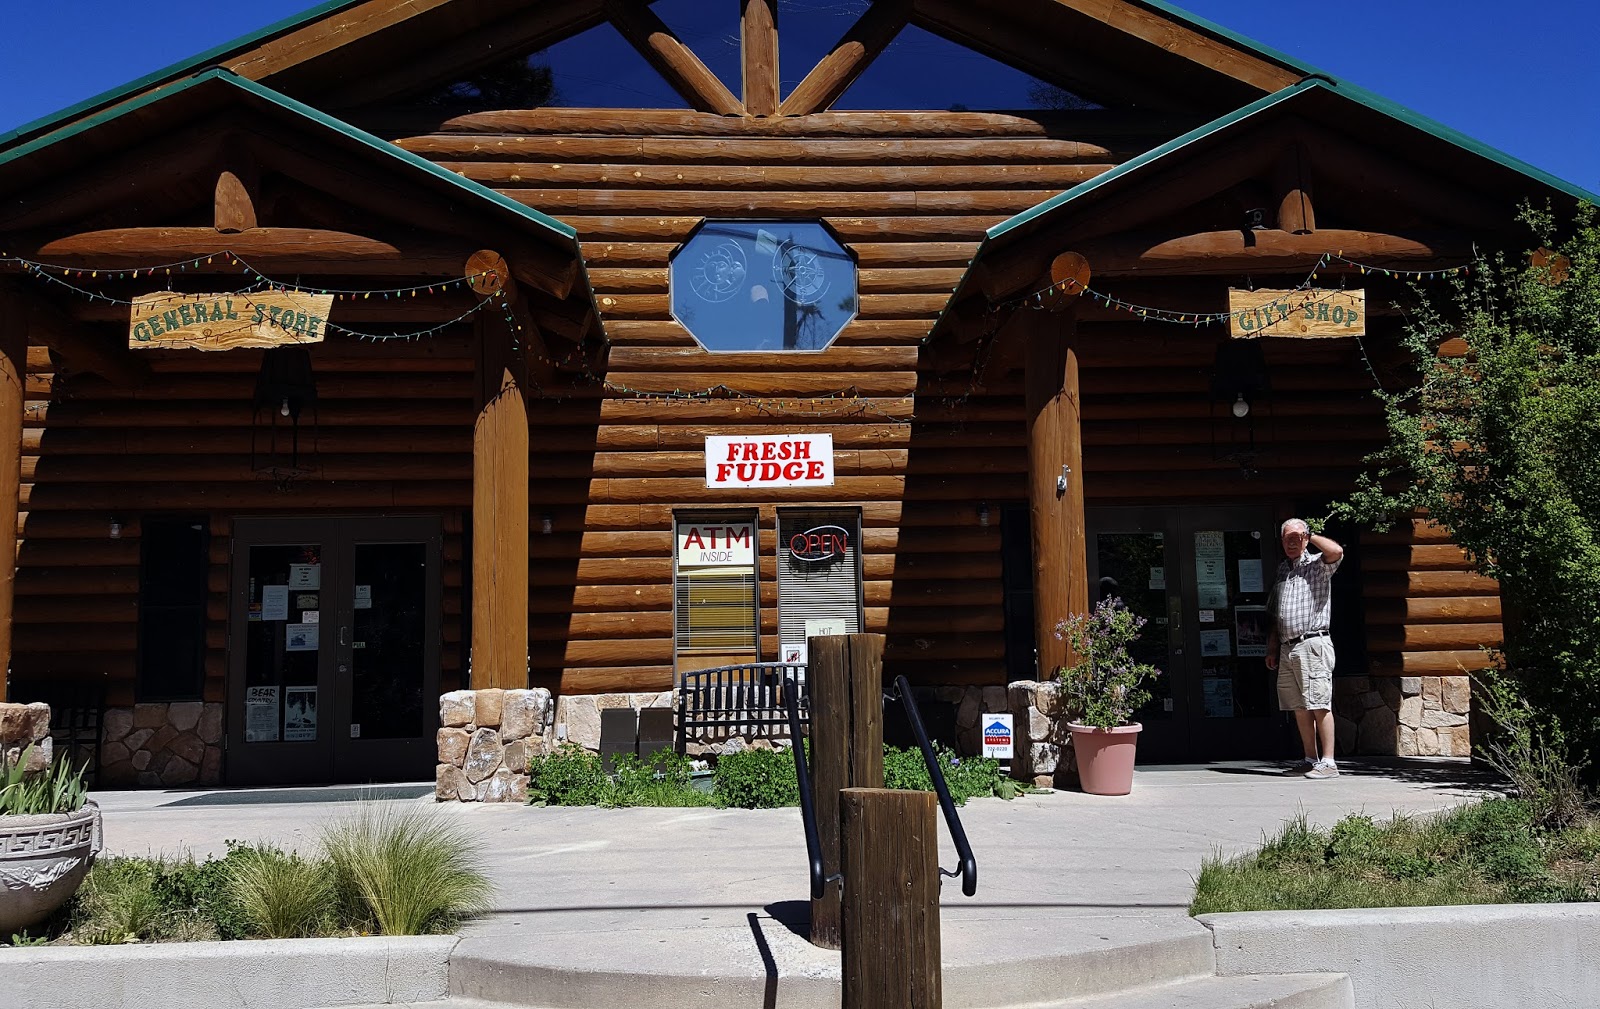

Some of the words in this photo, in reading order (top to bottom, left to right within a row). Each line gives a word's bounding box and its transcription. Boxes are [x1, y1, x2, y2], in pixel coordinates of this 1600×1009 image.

[133, 300, 238, 342] GENERAL
[251, 303, 323, 338] STORE
[1238, 303, 1289, 331] GIFT
[1304, 301, 1358, 328] SHOP
[726, 440, 812, 462] FRESH
[715, 461, 825, 482] FUDGE
[683, 526, 750, 550] ATM
[790, 533, 847, 554] OPEN
[700, 551, 733, 562] INSIDE
[818, 627, 832, 635] HOT
[252, 688, 276, 697] BEAR
